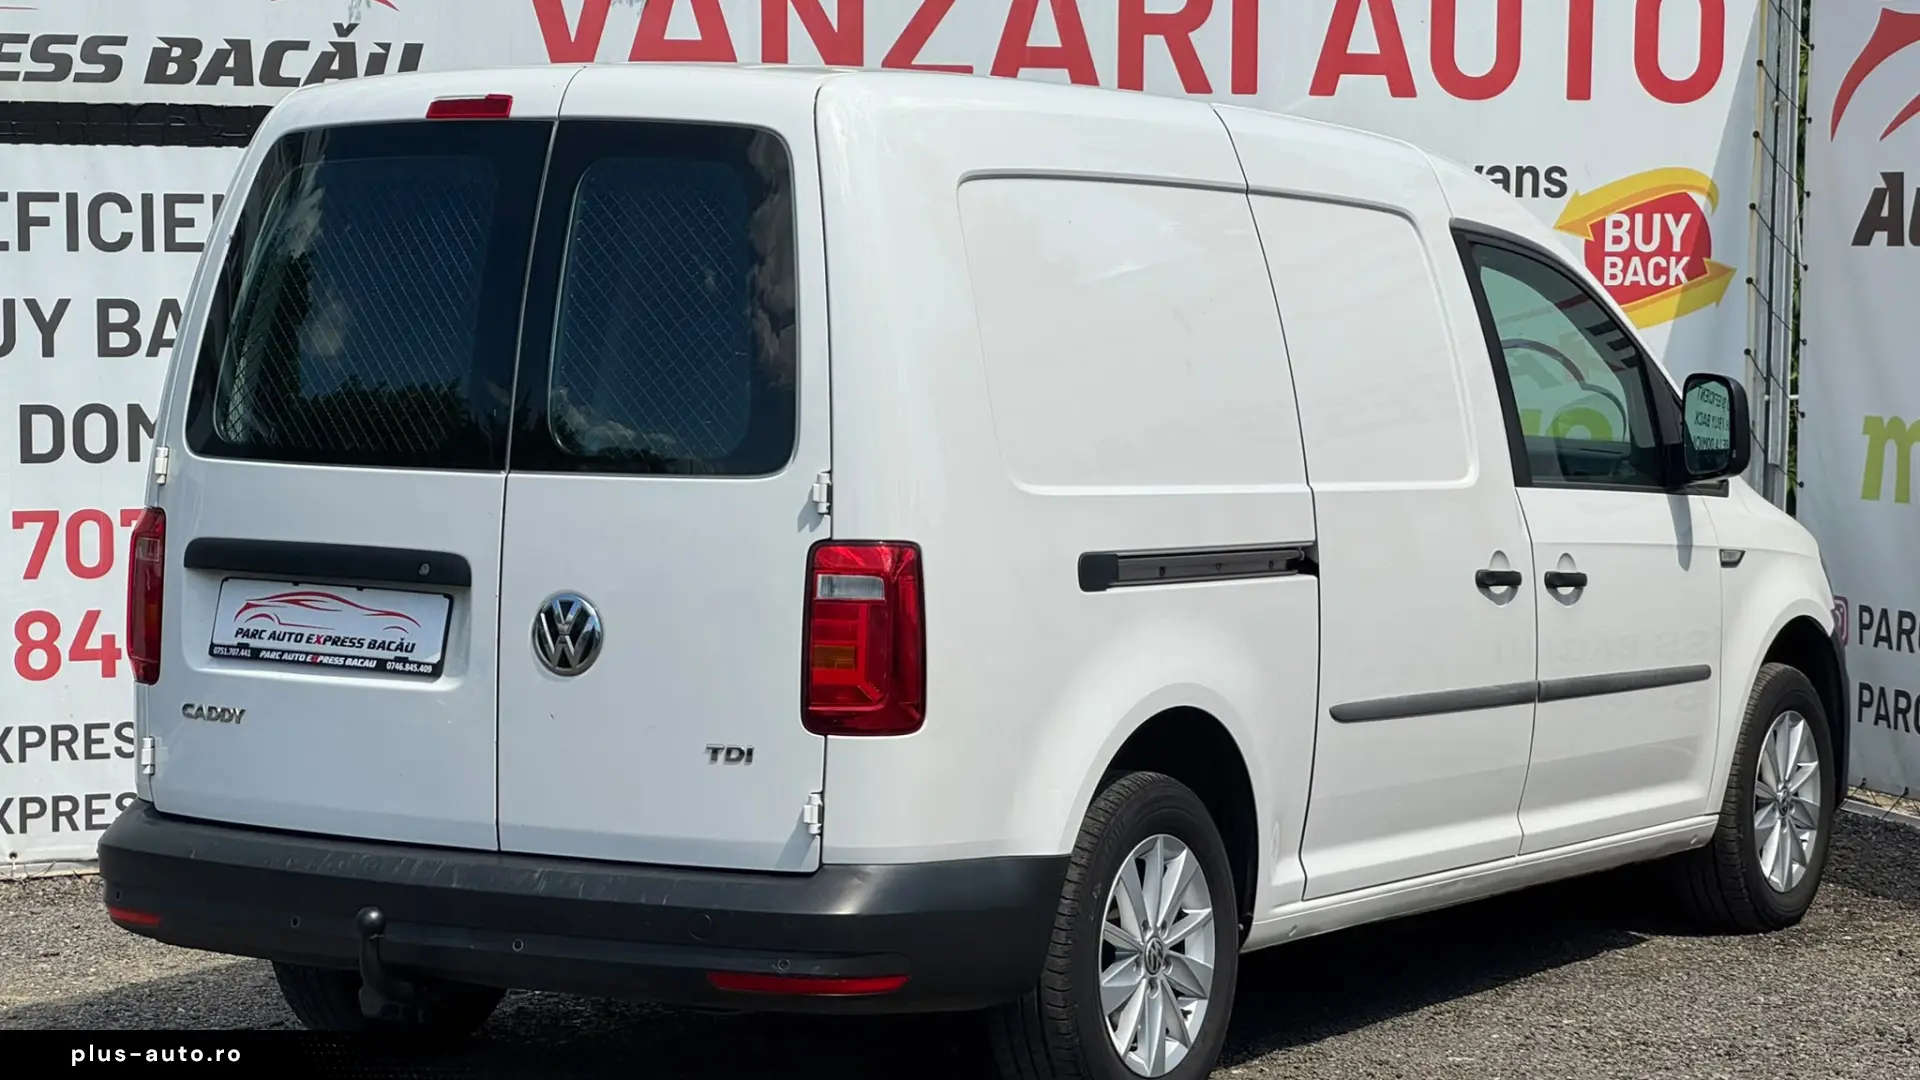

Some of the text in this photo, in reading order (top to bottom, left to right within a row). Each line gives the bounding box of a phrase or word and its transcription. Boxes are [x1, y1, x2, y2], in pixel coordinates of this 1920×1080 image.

[1475, 165, 1568, 198] ans
[0, 191, 225, 252] FICIE
[1851, 171, 1920, 247] A
[1604, 213, 1691, 252] BUY
[1603, 256, 1690, 286] BACK
[235, 627, 416, 653] PARC AUTO EXPRESS BACĂU
[1857, 604, 1920, 653] PAR
[14, 609, 121, 682] 84
[259, 650, 281, 660] PARC
[281, 652, 305, 662] AUTO
[306, 654, 345, 666] EXPRESS
[182, 703, 246, 724] CADDY
[705, 744, 755, 765] TDI
